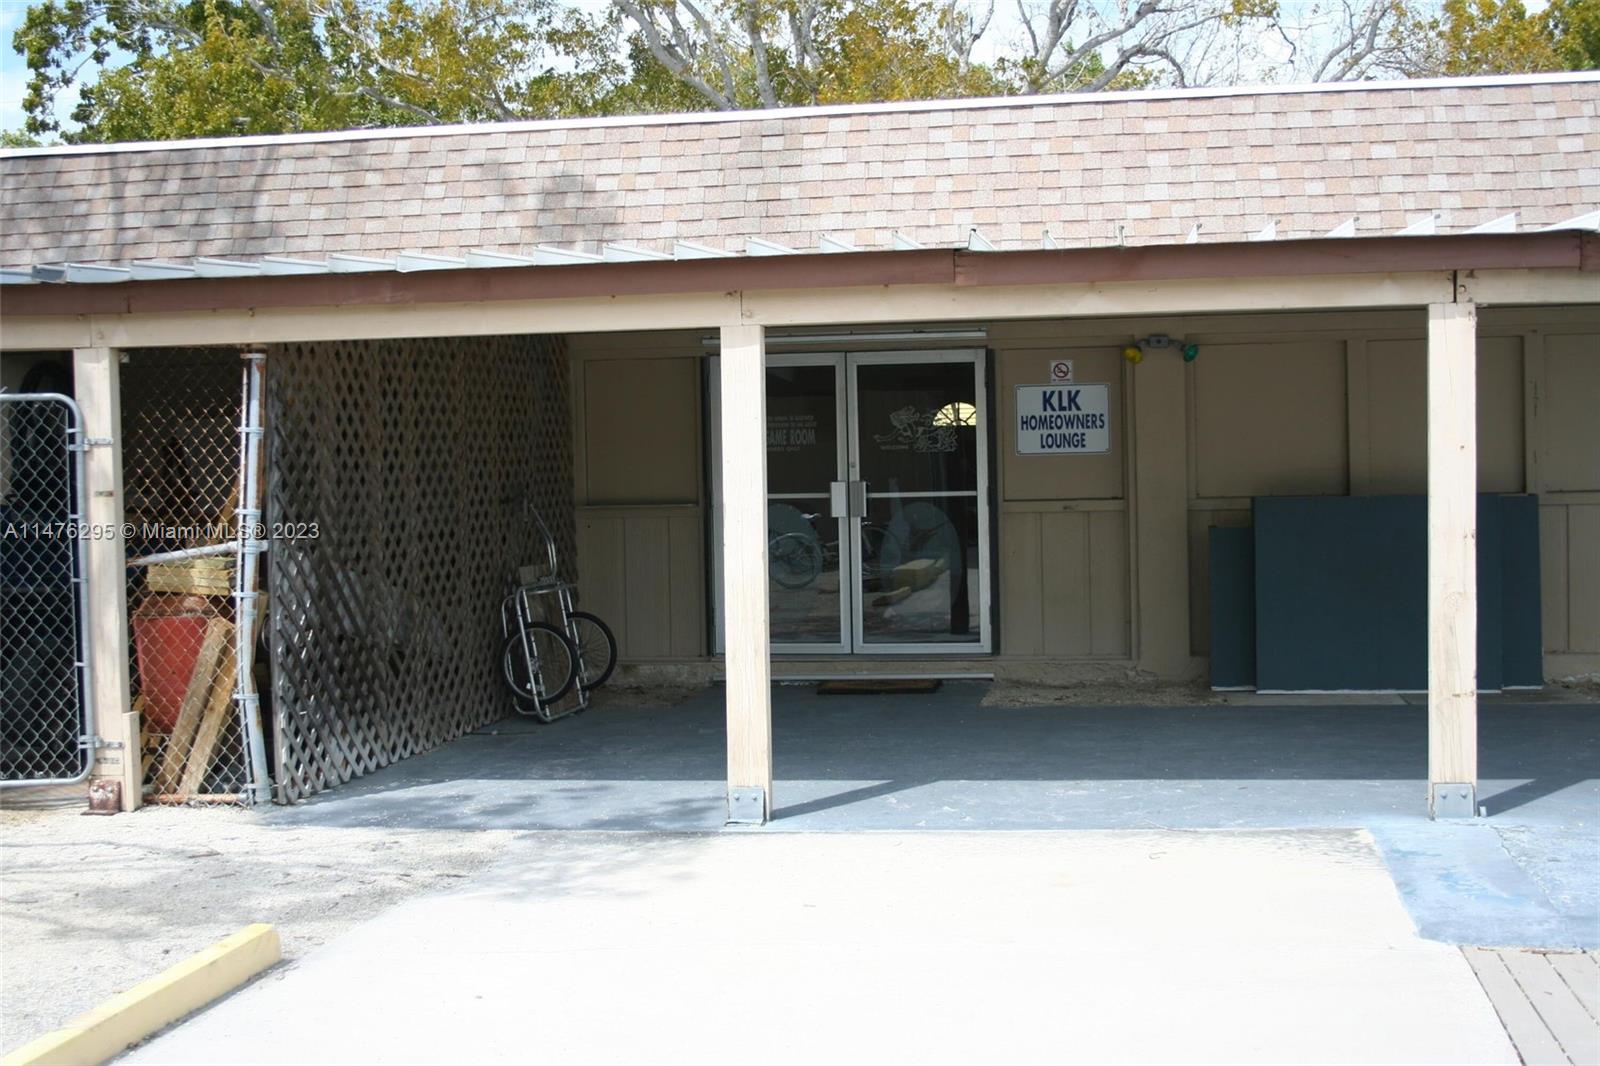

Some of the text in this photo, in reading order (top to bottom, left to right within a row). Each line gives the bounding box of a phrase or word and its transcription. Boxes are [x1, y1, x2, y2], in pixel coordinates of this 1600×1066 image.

[1042, 390, 1082, 412] KLK
[1020, 413, 1106, 431] HOMEOWNERS
[1040, 432, 1086, 449] LOUNGE
